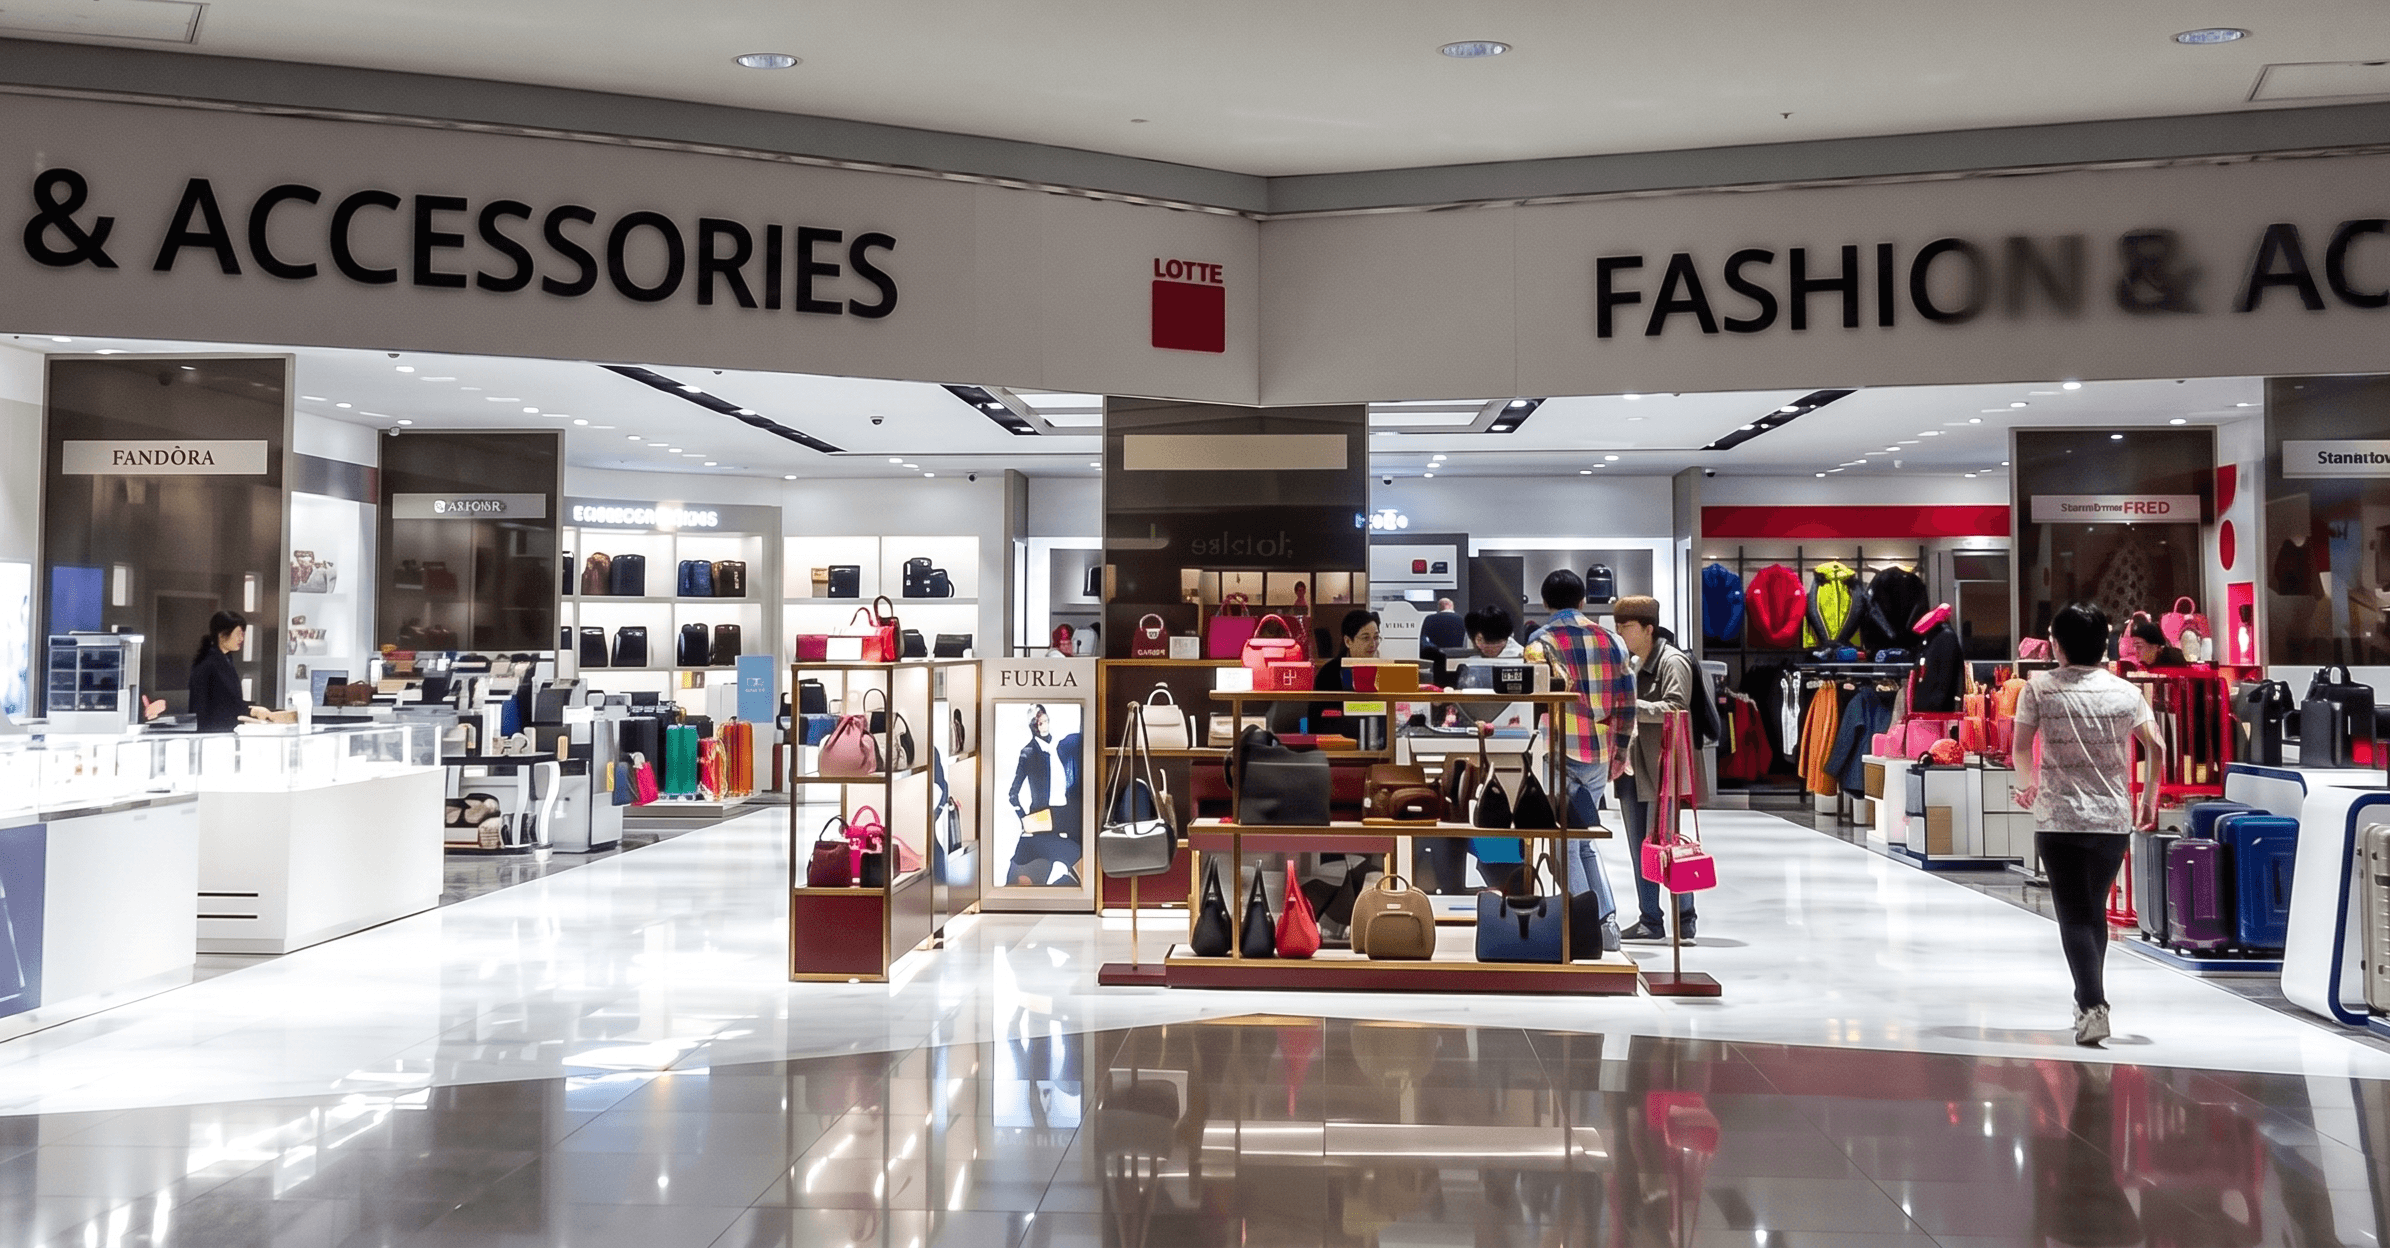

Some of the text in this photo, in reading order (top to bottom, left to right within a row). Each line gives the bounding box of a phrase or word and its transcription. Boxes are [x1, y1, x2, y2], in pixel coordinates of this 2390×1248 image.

[23, 168, 899, 319] & ACCESSORIES
[1154, 258, 1223, 284] LOTTE
[1597, 237, 2088, 339] FASHION
[2123, 501, 2170, 515] FRED
[1000, 670, 1078, 687] FURLA
